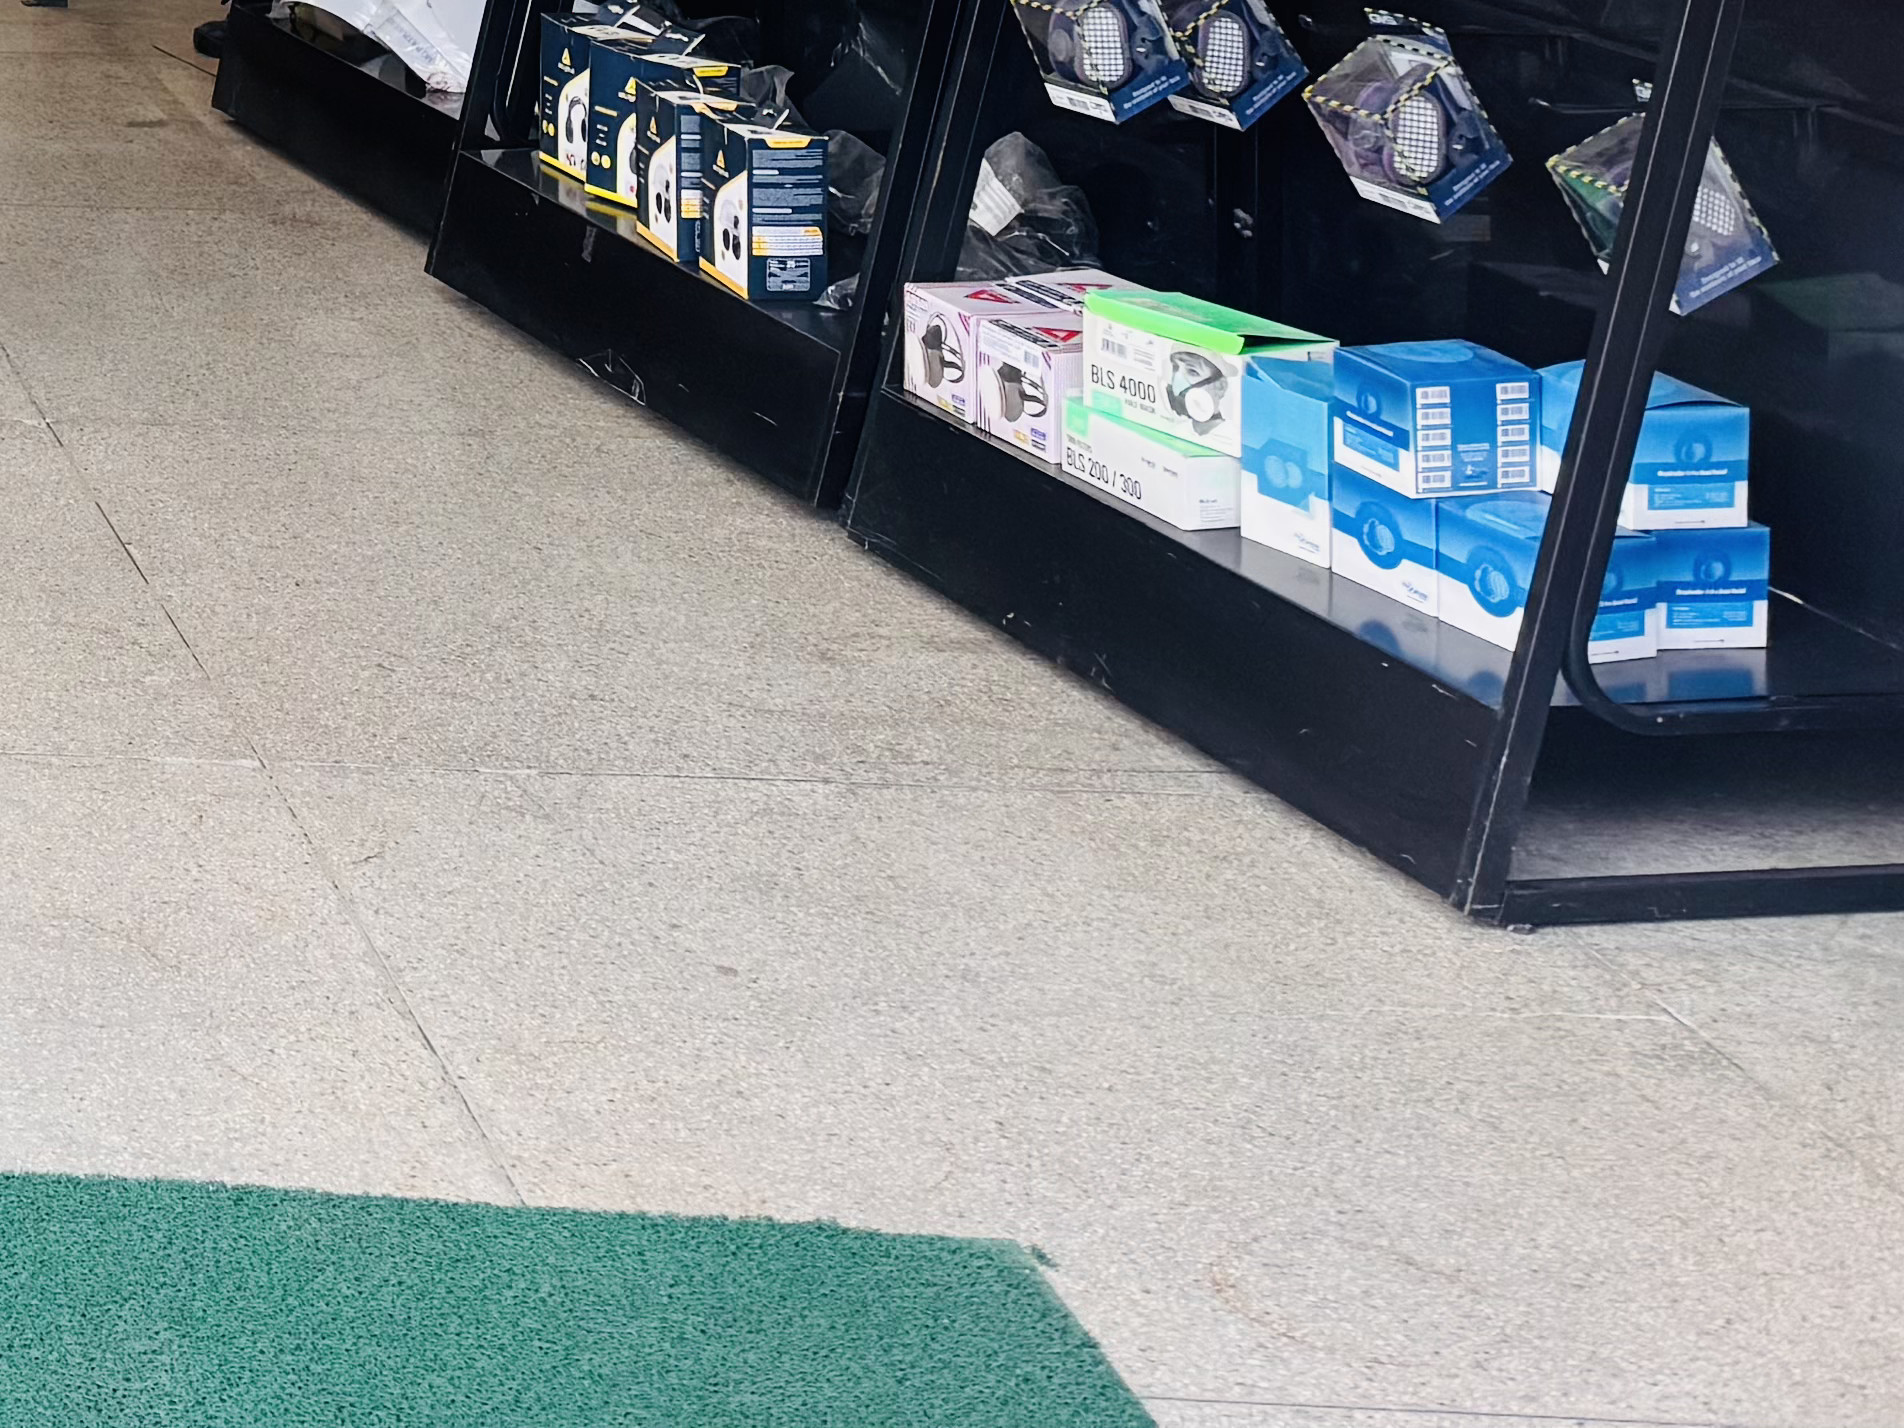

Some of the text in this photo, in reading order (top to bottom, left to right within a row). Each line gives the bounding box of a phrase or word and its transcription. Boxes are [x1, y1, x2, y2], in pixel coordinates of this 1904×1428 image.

[1091, 363, 1157, 404] BLS 4000
[1066, 445, 1086, 470] BLS
[1088, 454, 1110, 481] 200
[1118, 470, 1143, 500] 300
